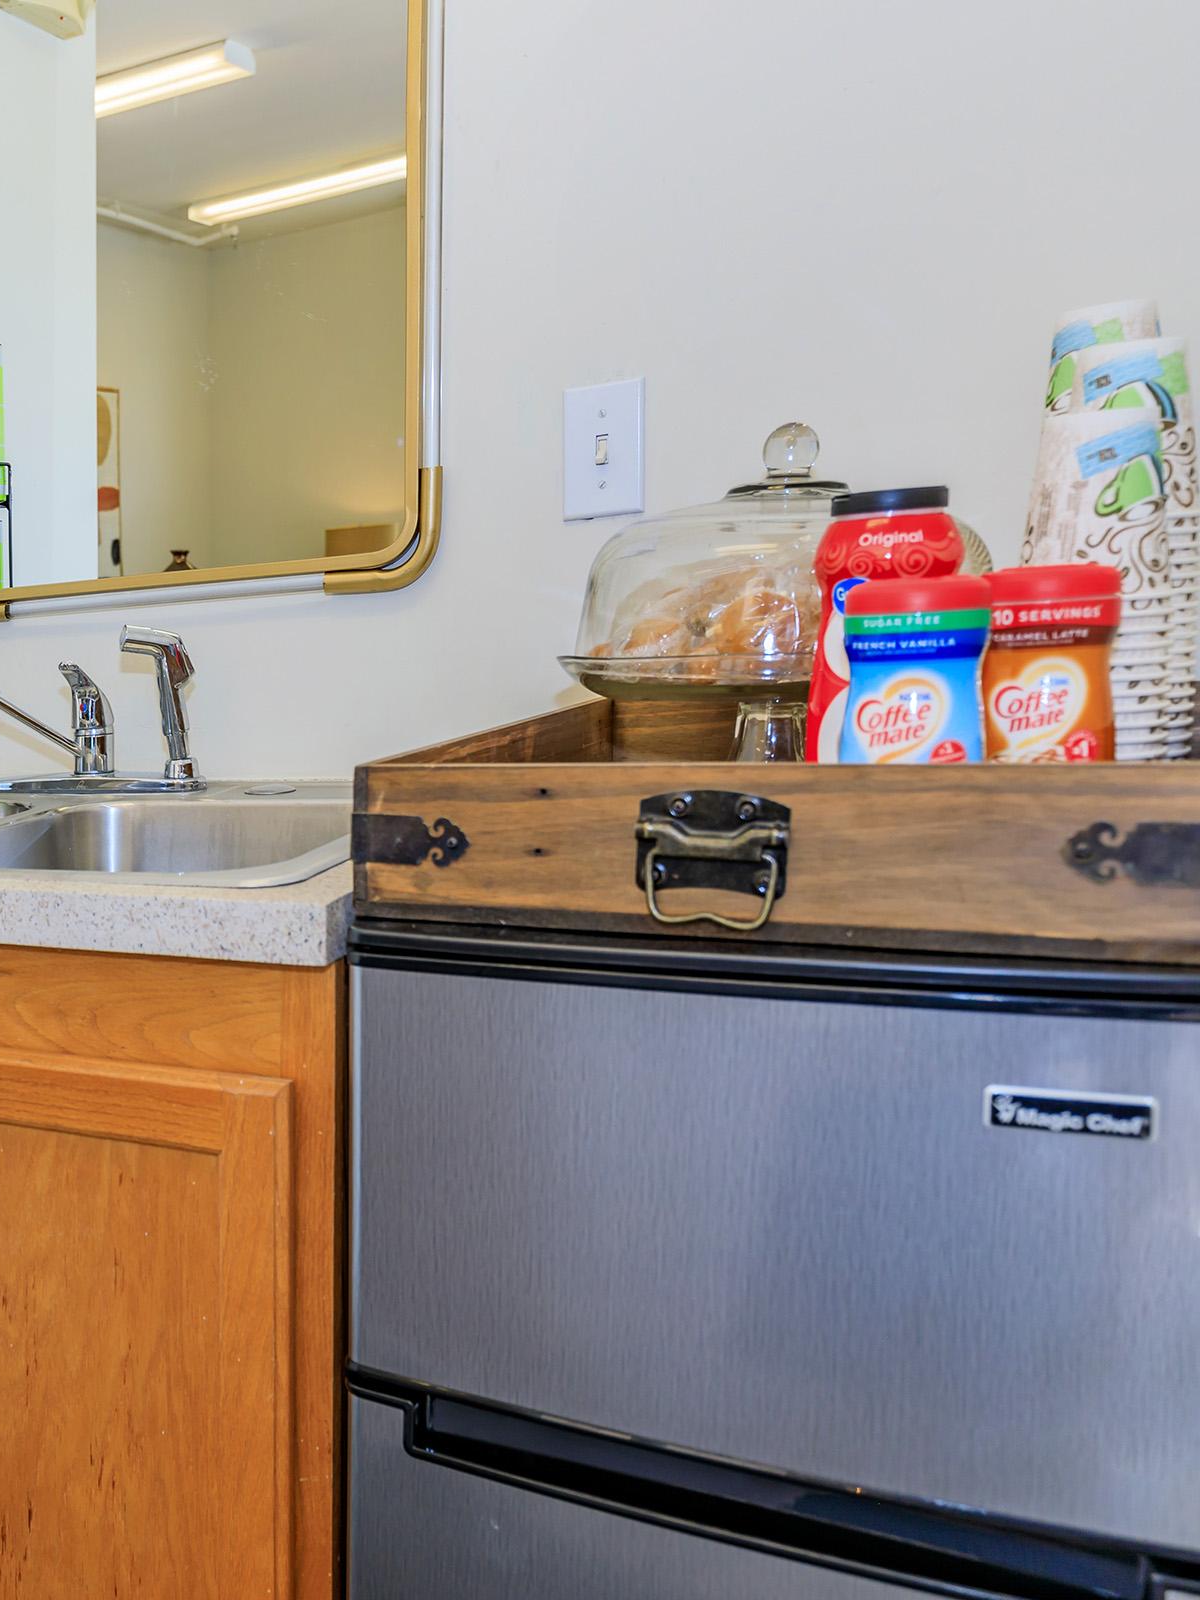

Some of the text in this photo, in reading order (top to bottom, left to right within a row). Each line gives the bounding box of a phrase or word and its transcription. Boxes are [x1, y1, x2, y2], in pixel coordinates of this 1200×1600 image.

[858, 530, 924, 547] Original
[863, 616, 940, 628] SUGAR FREE
[992, 606, 1101, 625] 10 SERVINGS
[852, 638, 956, 649] FRENCH VANILLA
[1052, 629, 1088, 640] LATTE
[857, 700, 931, 733] Coffee
[1009, 708, 1064, 732] mate
[869, 724, 925, 748] mate
[1016, 1108, 1143, 1135] Magic Chef
